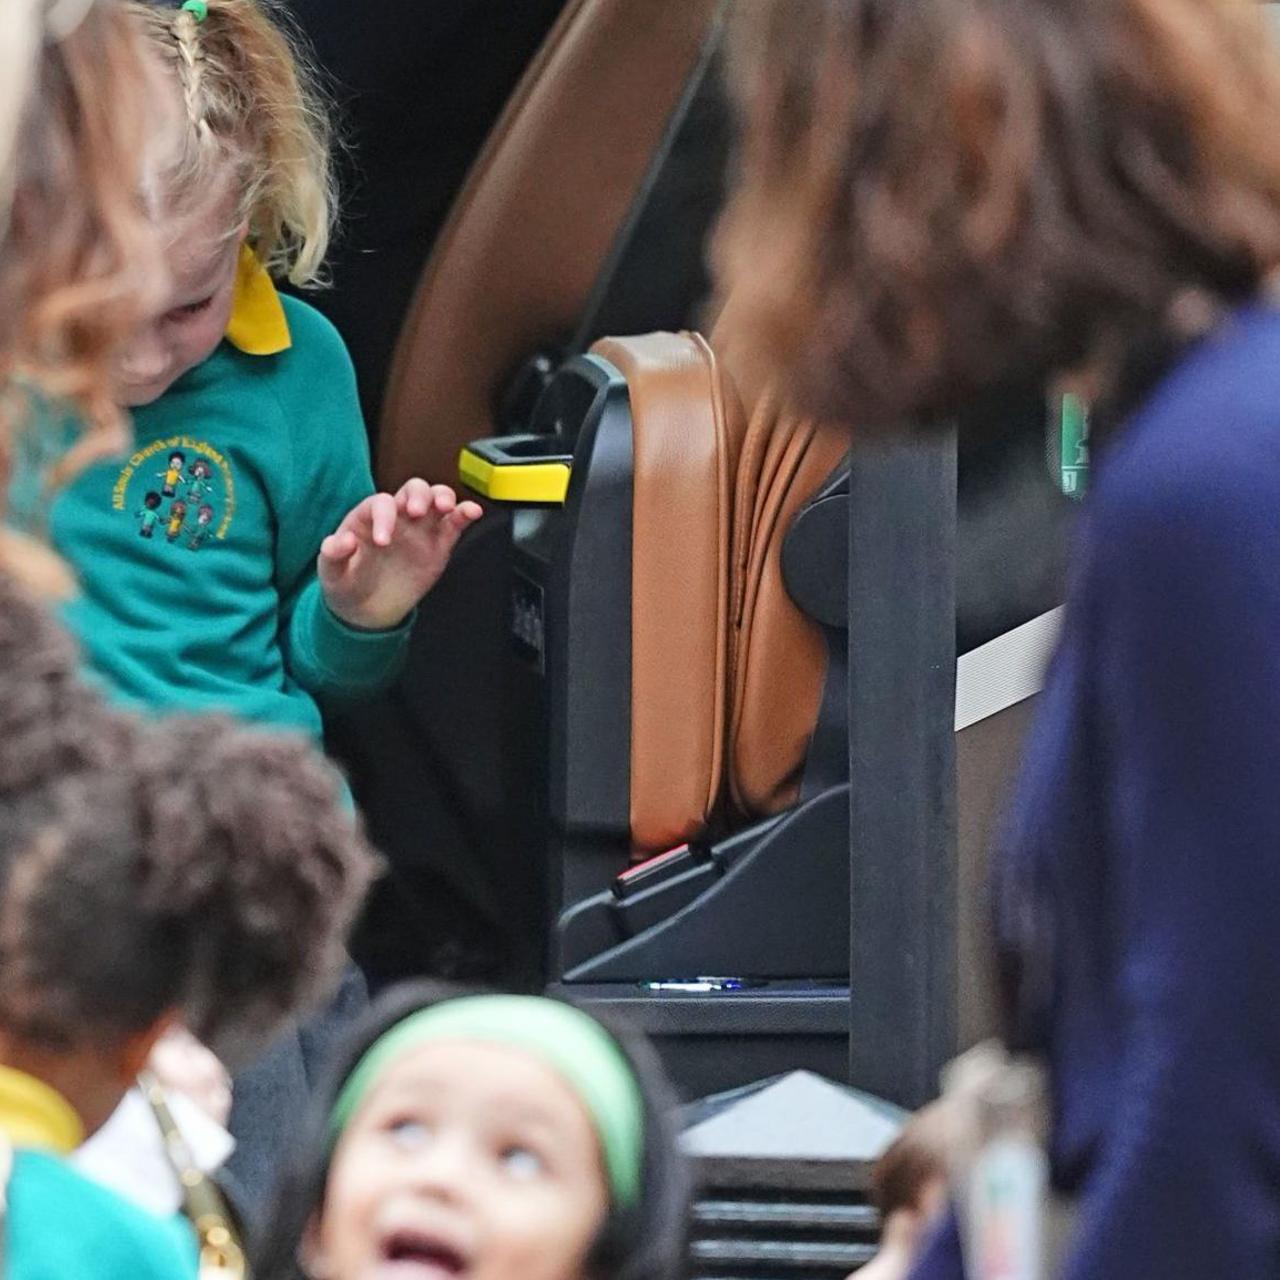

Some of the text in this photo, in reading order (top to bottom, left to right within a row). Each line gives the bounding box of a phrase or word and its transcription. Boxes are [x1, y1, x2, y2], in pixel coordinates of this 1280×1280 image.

[129, 440, 167, 466] Church
[167, 436, 180, 448] of
[181, 436, 223, 465] England
